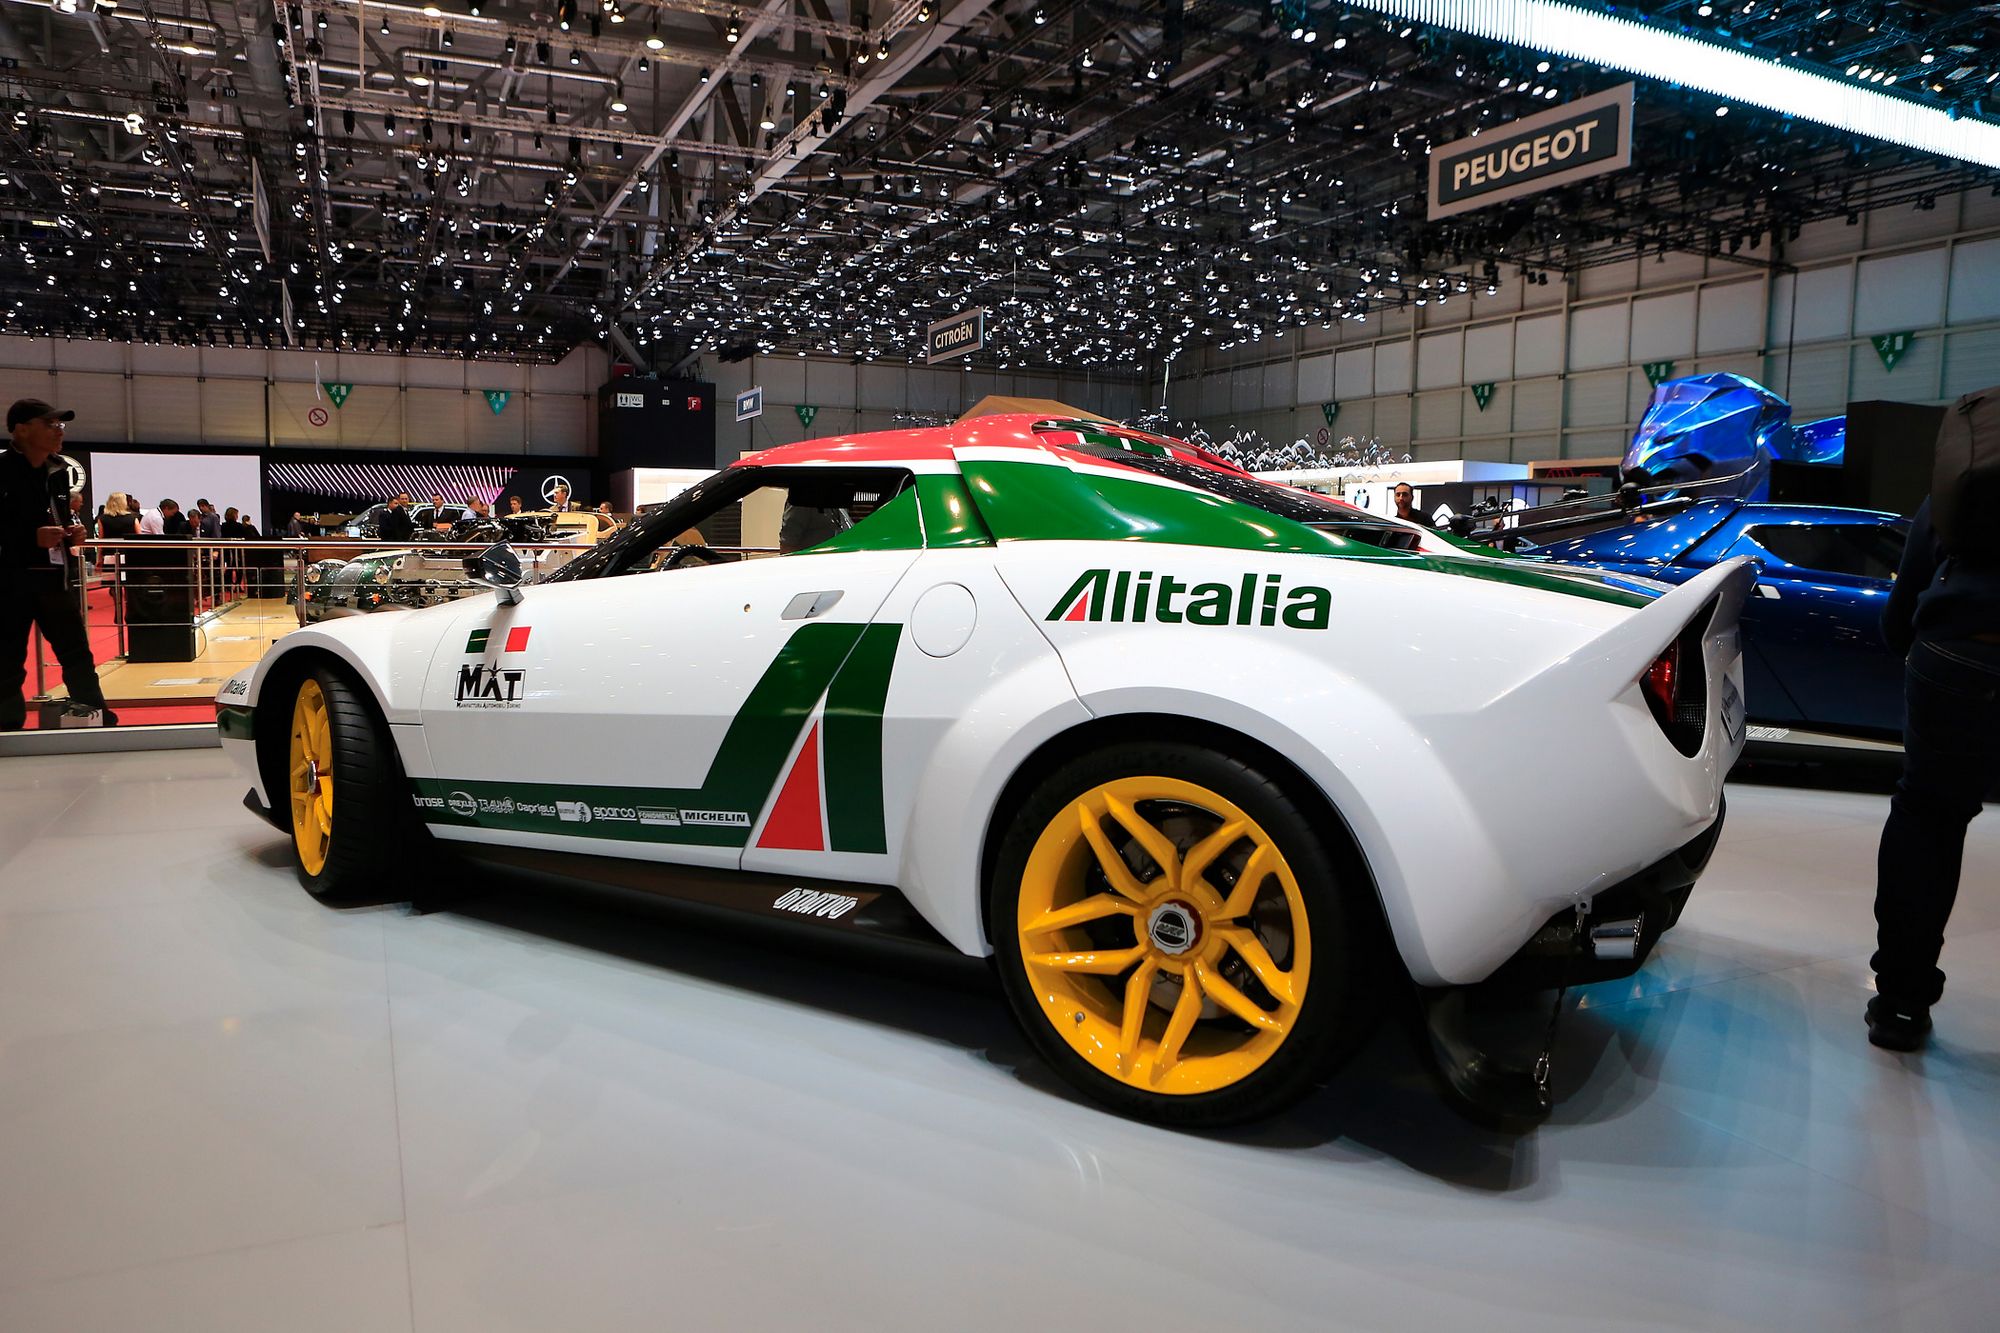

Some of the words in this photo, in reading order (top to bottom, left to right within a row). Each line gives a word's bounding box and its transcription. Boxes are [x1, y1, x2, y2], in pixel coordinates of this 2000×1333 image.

[226, 89, 236, 97] 10
[1453, 120, 1599, 191] PEUGEOT
[935, 321, 973, 349] CITROËN
[1044, 568, 1332, 630] Alitalia
[457, 662, 522, 701] MAT
[412, 793, 445, 808] brose
[593, 806, 636, 821] sparco
[685, 811, 746, 822] MICHELIN
